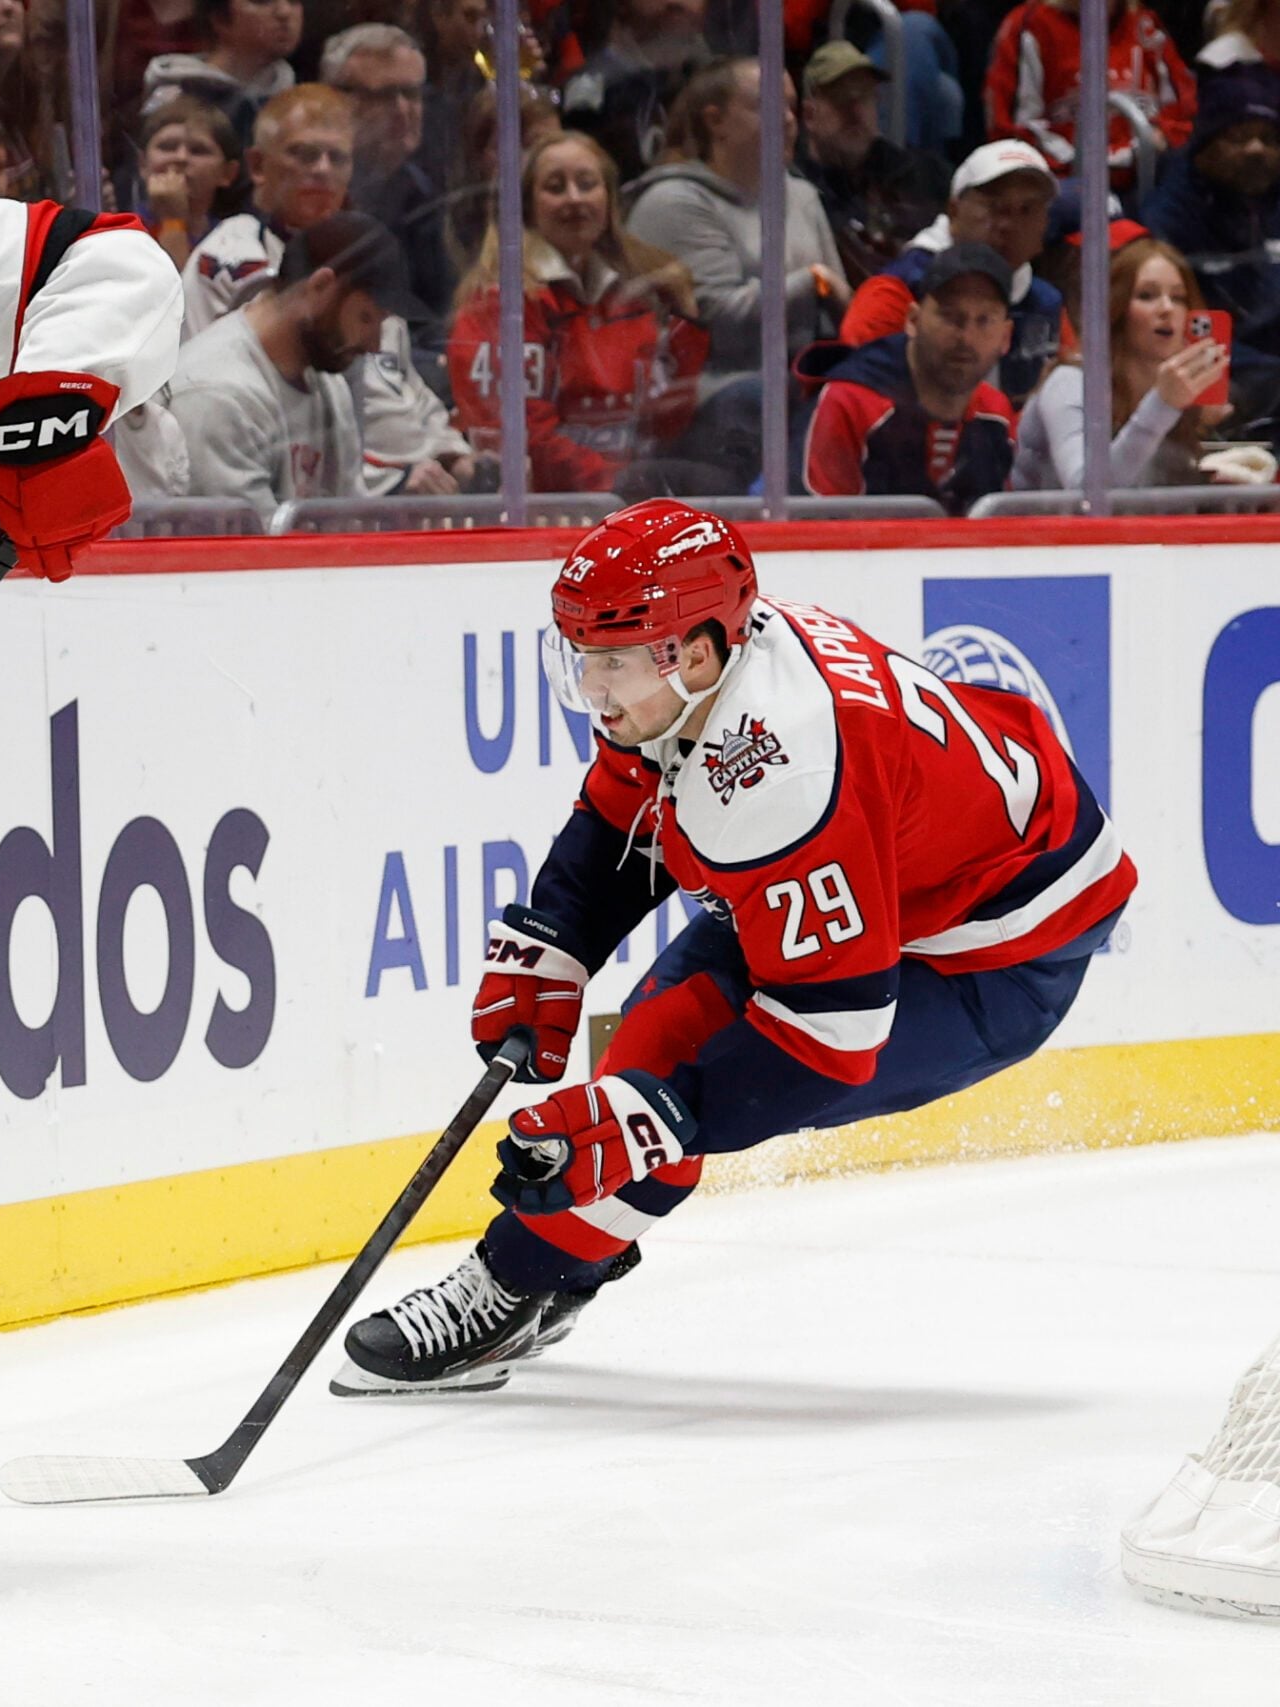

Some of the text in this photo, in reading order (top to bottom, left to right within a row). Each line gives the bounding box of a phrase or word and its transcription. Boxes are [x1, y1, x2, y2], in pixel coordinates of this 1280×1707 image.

[563, 554, 598, 584] 29
[711, 734, 778, 790] CAPITALS
[522, 916, 559, 939] LAPIERRE
[764, 861, 865, 961] 29
[656, 1087, 685, 1124] LAPIERRE
